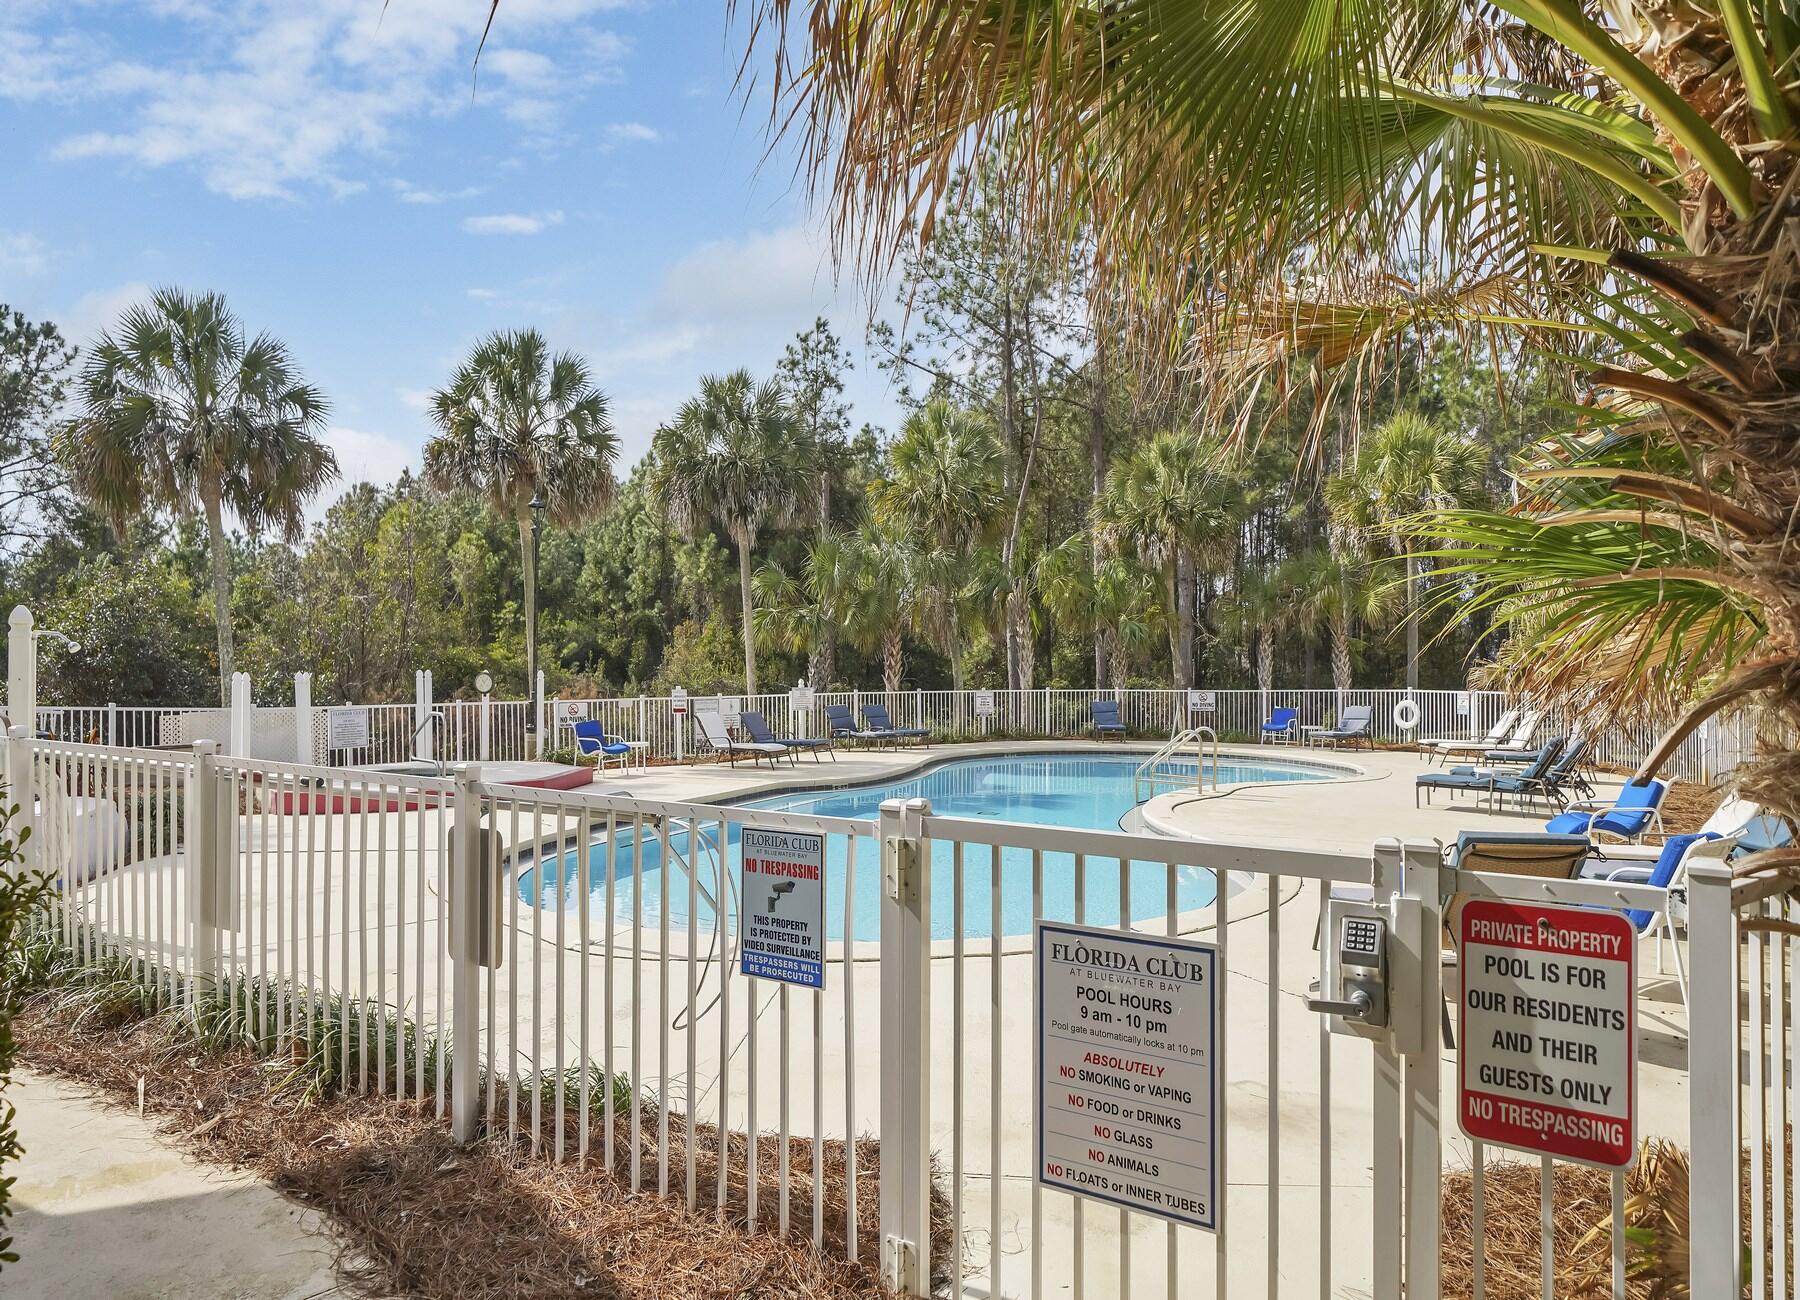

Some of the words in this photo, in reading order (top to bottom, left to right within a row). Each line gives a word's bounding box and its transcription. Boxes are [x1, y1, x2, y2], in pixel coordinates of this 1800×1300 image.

[746, 833, 789, 848] FLORIDA
[792, 838, 819, 851] CLUB
[764, 849, 796, 858] BLUEWATER
[745, 858, 757, 872] NO
[760, 860, 818, 880] TRESPASSING
[750, 927, 757, 937] IS
[760, 929, 799, 944] PROTECTED
[802, 935, 811, 946] BY
[754, 915, 769, 926] THIS
[771, 917, 808, 932] PROPERTY
[1471, 919, 1533, 945] PRIVATE
[1537, 926, 1622, 955] PROPERTY
[744, 939, 764, 951] VIDEO
[767, 943, 820, 961] SURVEILLANCE
[744, 953, 798, 970] TRESPASSERS
[801, 963, 820, 974] WILL
[1051, 942, 1141, 972] FLORIDA
[1146, 957, 1203, 982] CLUB
[750, 964, 759, 973] BE
[762, 966, 814, 983] PROSECUTED
[1070, 968, 1082, 978] AT
[1087, 970, 1154, 989] BLUEWATER
[1160, 982, 1181, 993] BAY
[1484, 955, 1534, 980] POOL
[1541, 962, 1560, 983] IS
[1567, 965, 1606, 990] FOR
[1077, 986, 1115, 1005] POOL
[1120, 993, 1172, 1015] HOURS
[1468, 989, 1506, 1013] OUR
[1513, 996, 1625, 1031] RESIDENTS
[1081, 1005, 1088, 1019] 9
[1092, 1010, 1112, 1024] am
[1126, 1013, 1141, 1029] 10
[1146, 1020, 1167, 1035] pm
[1052, 1020, 1069, 1030] Pool
[1070, 1024, 1087, 1035] gate
[1089, 1027, 1141, 1047] automatically
[1144, 1036, 1164, 1050] locks
[1167, 1042, 1174, 1051] at
[1178, 1043, 1188, 1054] 10
[1191, 1047, 1204, 1057] pm
[1492, 1030, 1532, 1054] AND
[1539, 1036, 1597, 1065] THEIR
[1084, 1052, 1165, 1078] ABSOLUTELY
[1060, 1065, 1076, 1079] NO
[1079, 1069, 1130, 1091] SMOKING
[1134, 1082, 1145, 1094] or
[1148, 1084, 1192, 1104] VAPING
[1480, 1064, 1554, 1095] GUESTS
[1560, 1078, 1612, 1106] ONLY
[1068, 1094, 1084, 1108] NO
[1087, 1098, 1119, 1116] FOOD
[1123, 1108, 1134, 1119] or
[1137, 1110, 1181, 1130] DRINKS
[1469, 1096, 1492, 1120] NO
[1498, 1102, 1624, 1147] TRESPASSING
[1094, 1125, 1111, 1139] NO
[1114, 1129, 1153, 1149] GLASS
[1088, 1149, 1104, 1163] NO
[1107, 1153, 1159, 1177] ANIMALS
[1047, 1162, 1063, 1177] NO
[1066, 1168, 1108, 1190] FLOATS
[1112, 1182, 1123, 1193] or
[1126, 1183, 1162, 1203] INNER
[1165, 1193, 1205, 1215] TUBES
